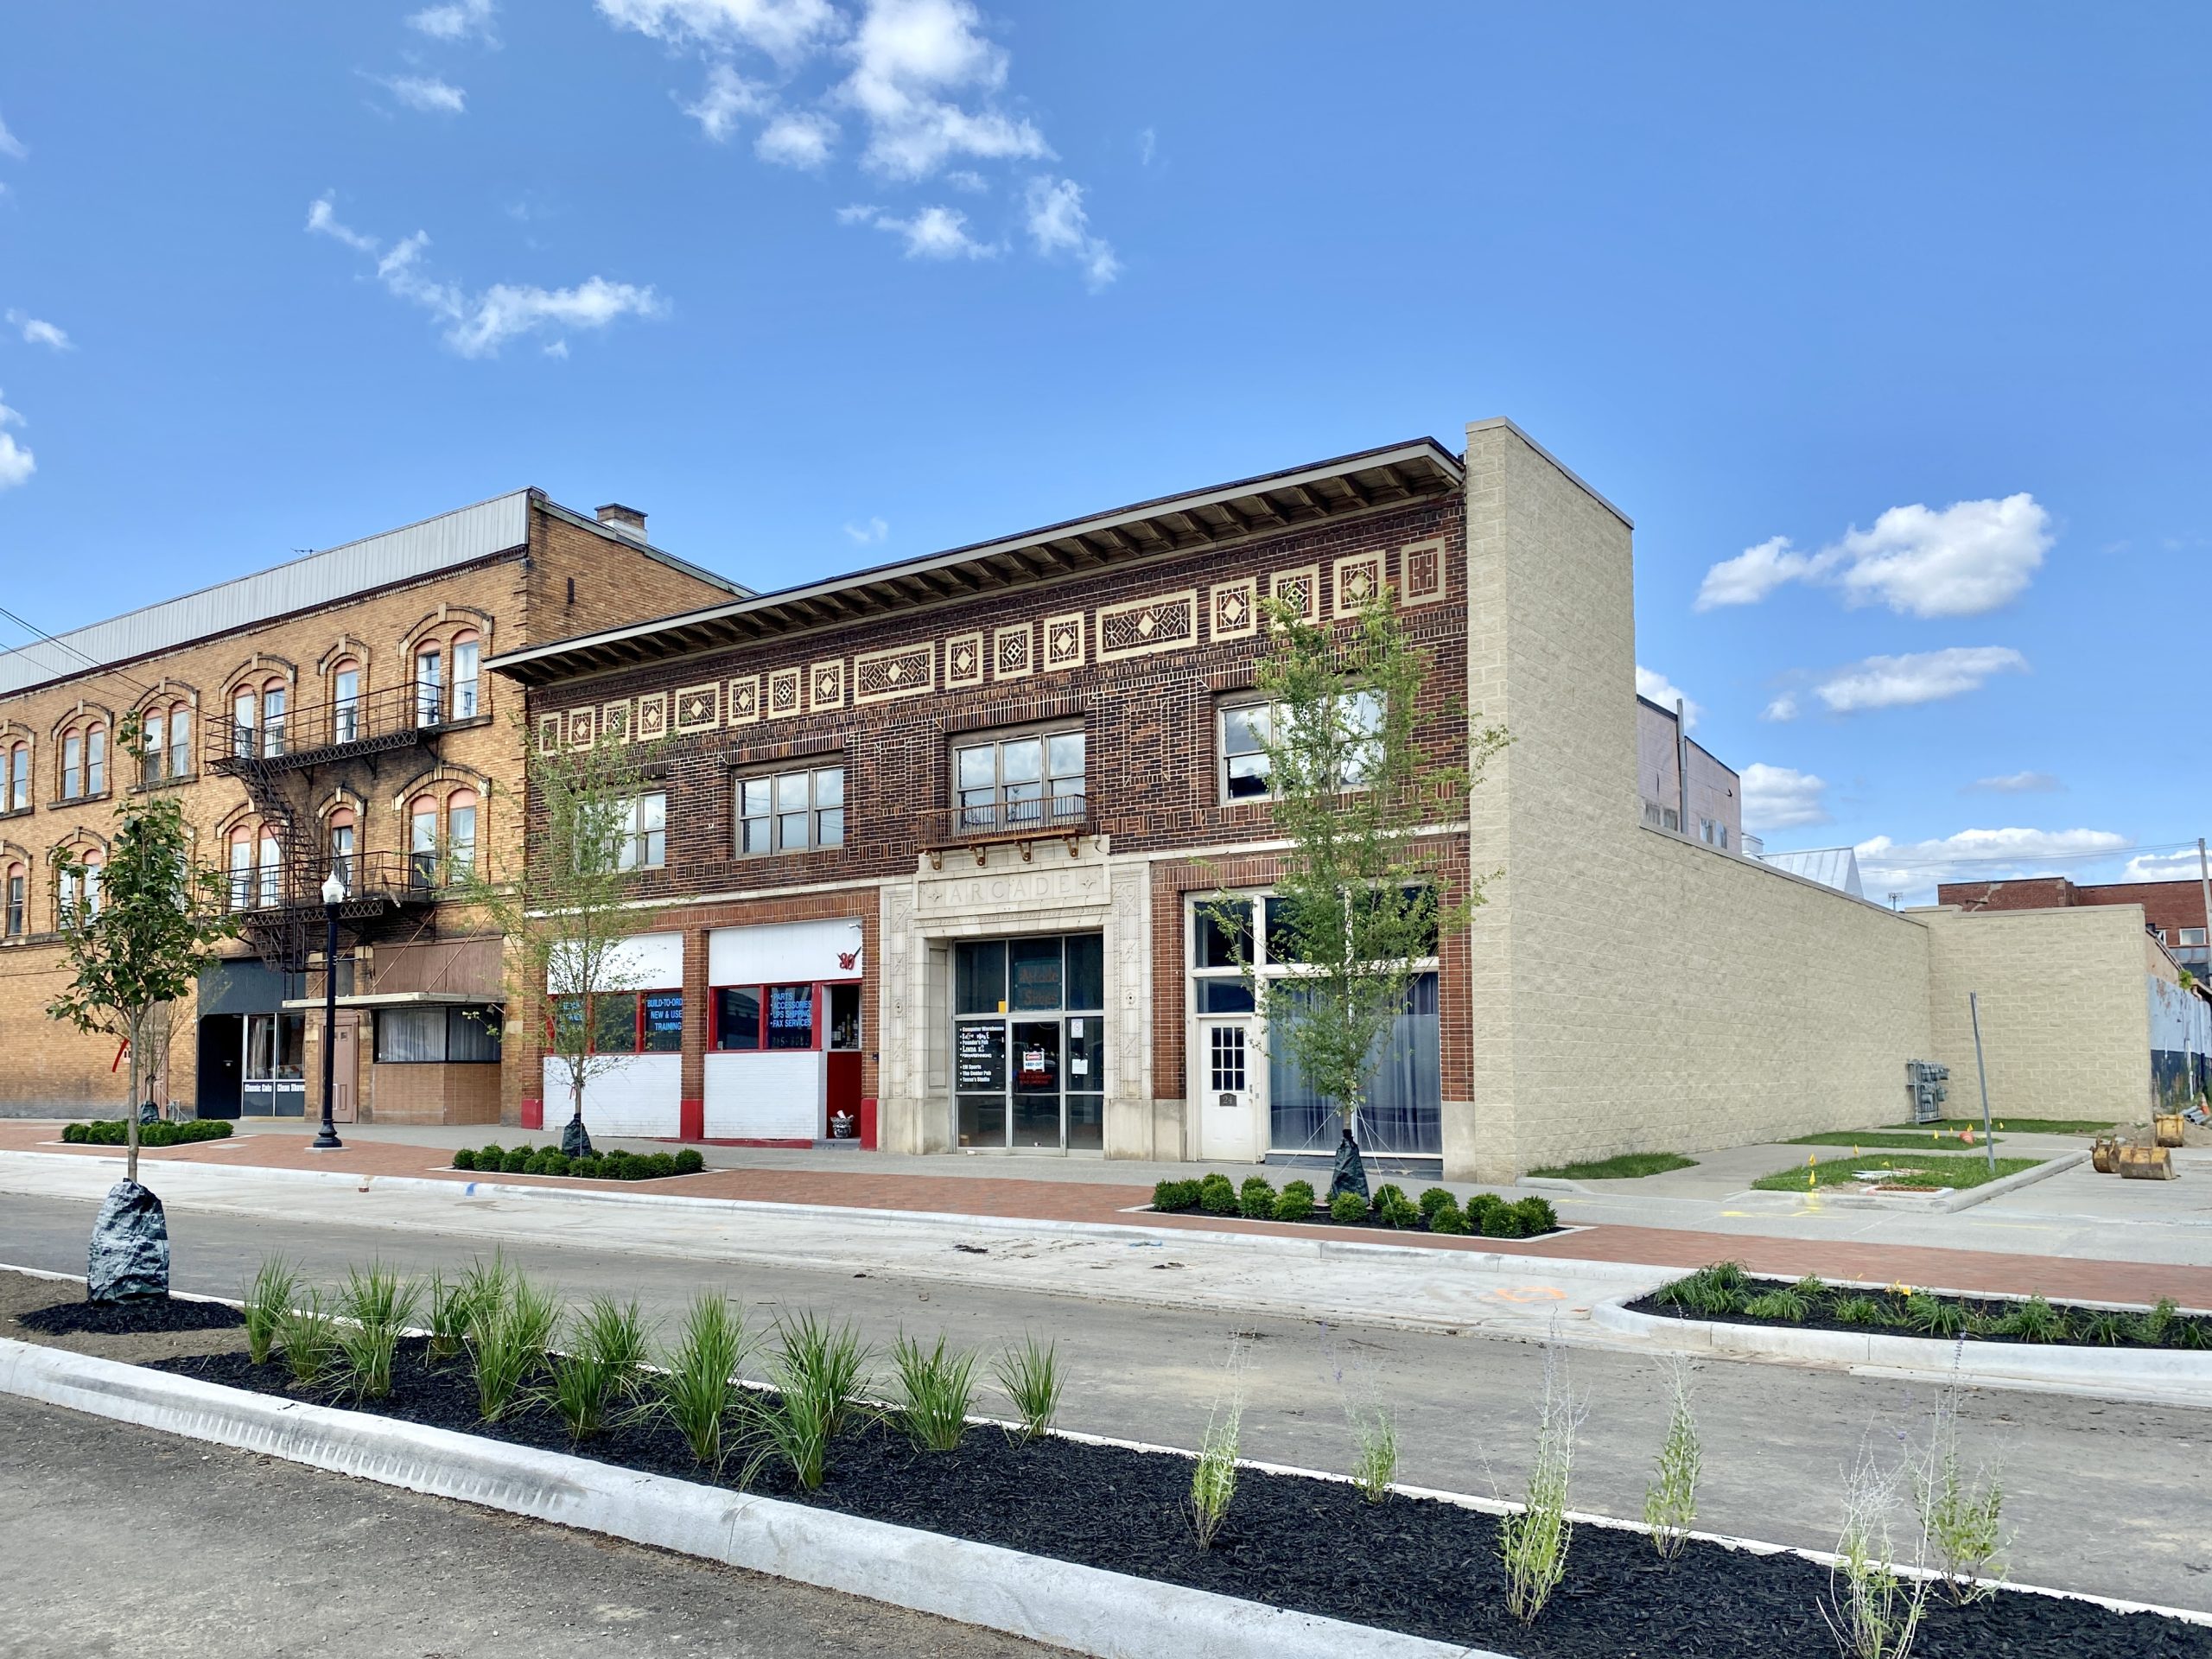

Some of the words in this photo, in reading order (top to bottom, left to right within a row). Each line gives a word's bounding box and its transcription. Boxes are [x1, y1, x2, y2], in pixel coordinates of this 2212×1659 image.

[950, 874, 1071, 902] ARCADE
[773, 1001, 812, 1010] ACCESSORIES
[651, 1010, 664, 1020] NEW
[664, 1010, 670, 1019] &
[772, 1010, 785, 1019] UPS
[785, 1009, 810, 1019] SHIPPING
[655, 1022, 682, 1031] TRAINING
[772, 1020, 784, 1028] FAX
[785, 1019, 812, 1027] SERVICES
[1223, 1096, 1233, 1104] 24
